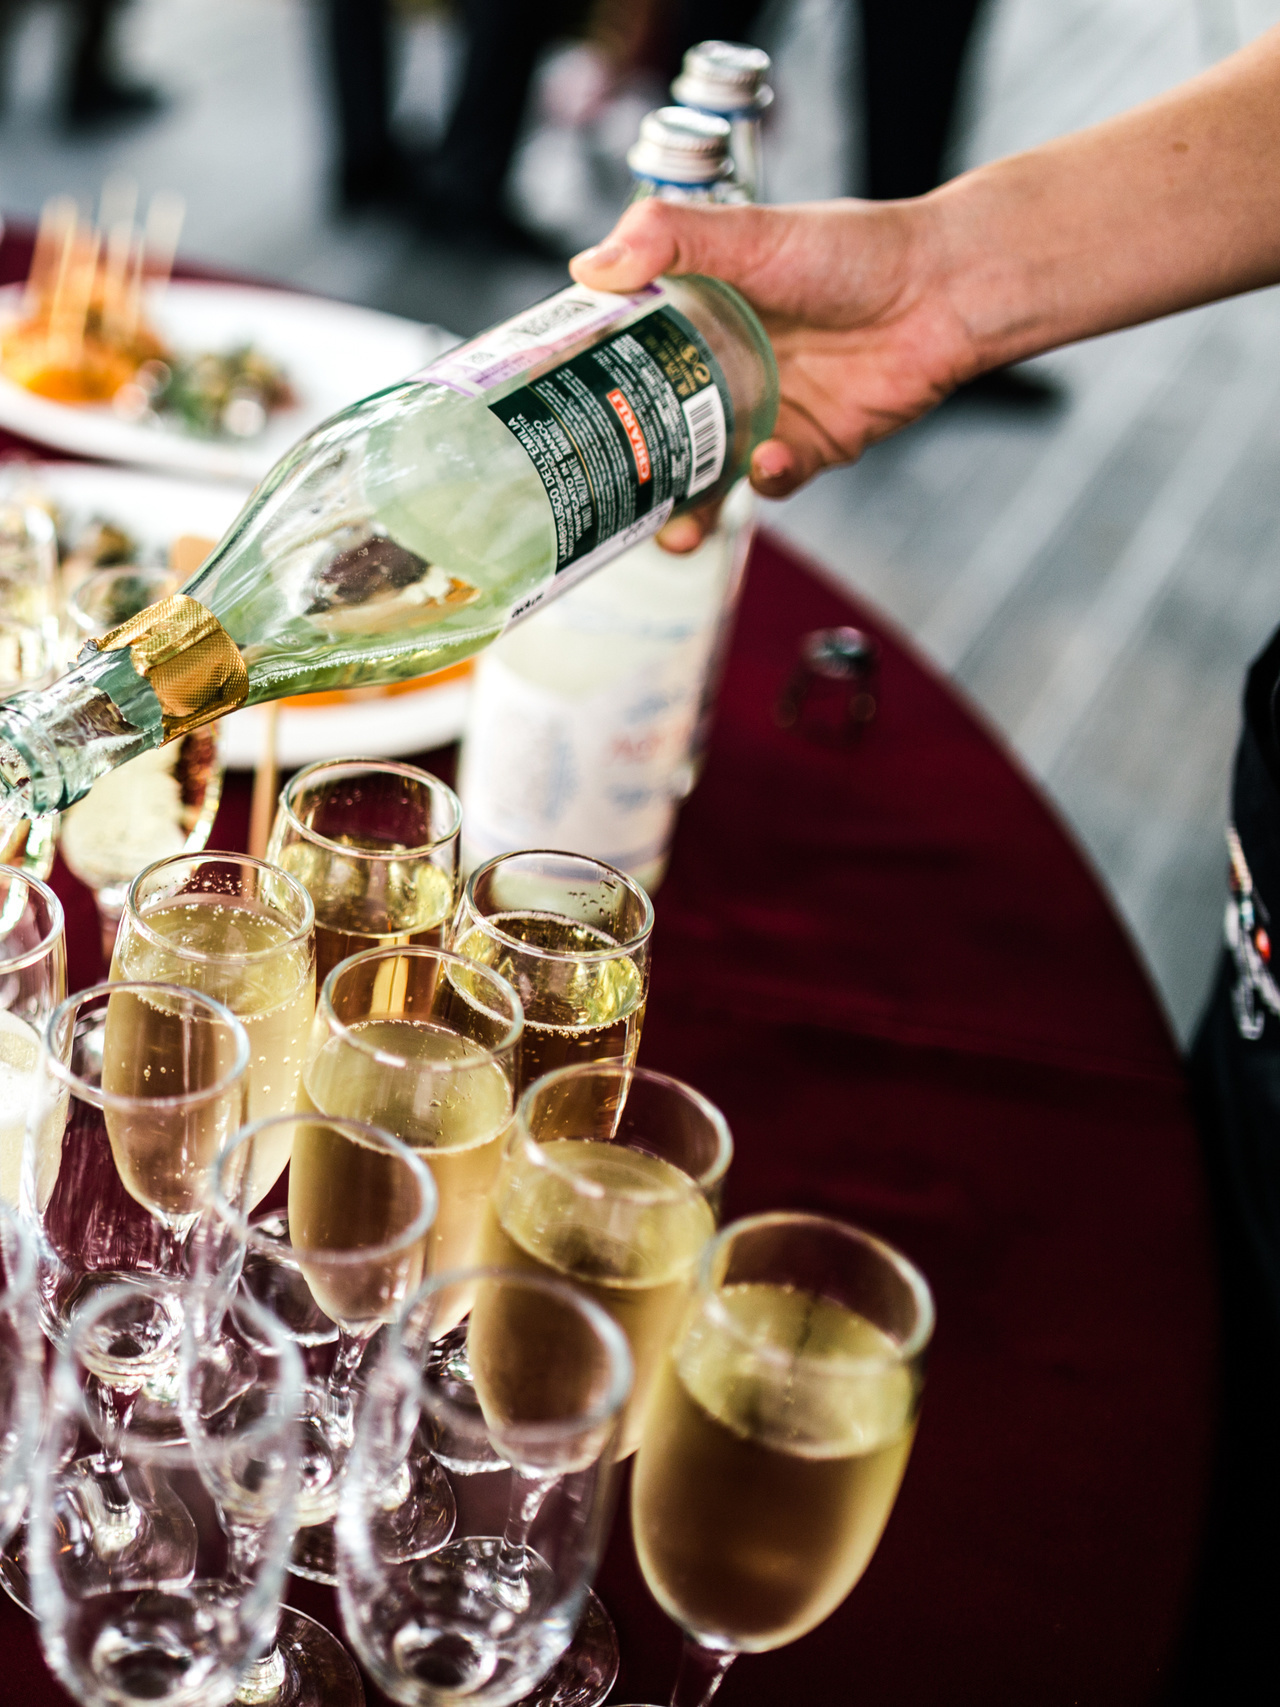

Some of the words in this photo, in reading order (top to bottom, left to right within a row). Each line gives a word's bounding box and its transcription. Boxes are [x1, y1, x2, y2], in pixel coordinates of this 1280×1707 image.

[516, 412, 548, 452] PROTETTA
[532, 418, 564, 461] BIANCO
[542, 415, 574, 455] AMABILE
[610, 392, 651, 479] CHIARLI
[543, 450, 570, 505] GEOGRAFICA
[559, 461, 570, 475] IN
[566, 454, 590, 506] FRIZZANTE
[548, 487, 568, 563] LAMBRUSCO
[564, 477, 582, 540] VINIFICATO
[581, 504, 593, 531] VINO
